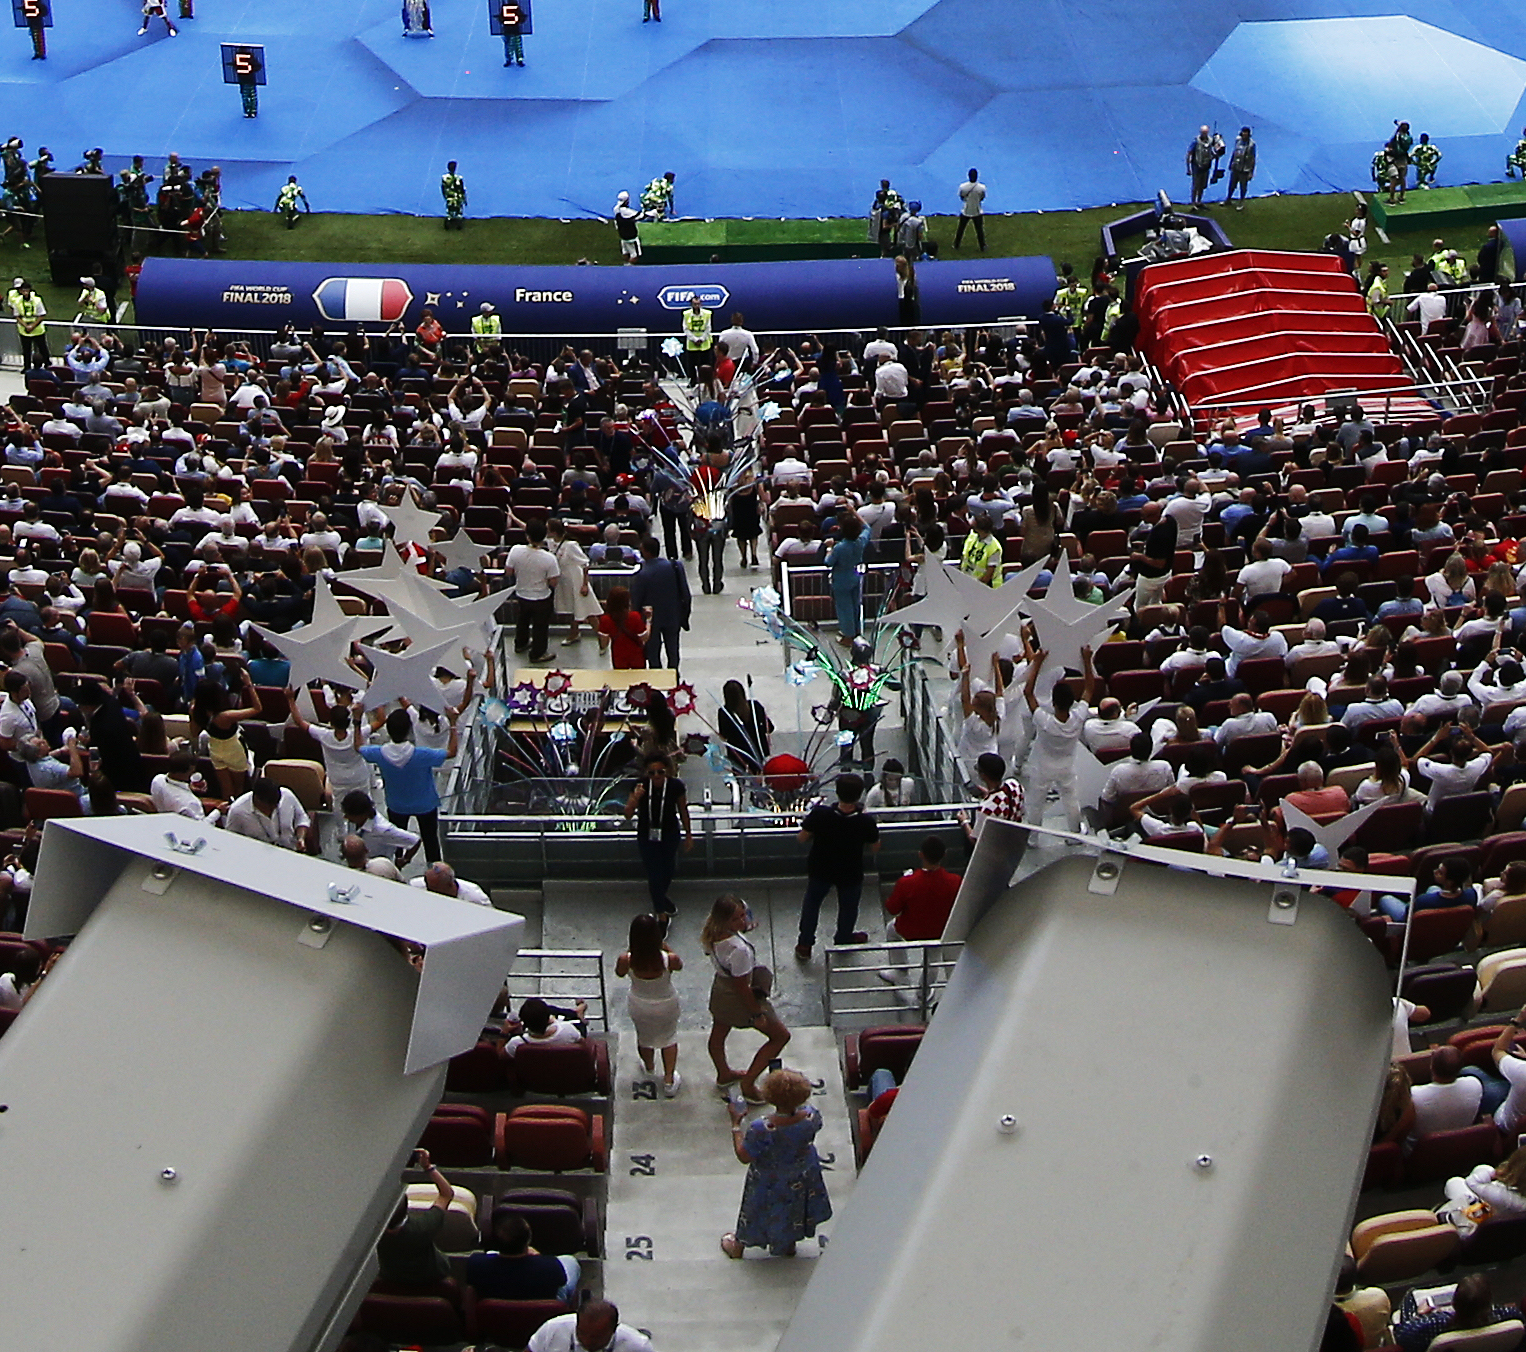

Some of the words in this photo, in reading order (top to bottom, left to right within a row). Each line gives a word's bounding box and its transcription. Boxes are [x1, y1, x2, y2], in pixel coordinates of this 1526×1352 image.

[503, 6, 518, 24] 5
[236, 54, 251, 73] 5
[514, 288, 573, 303] France
[667, 291, 720, 302] FIFAcom
[957, 283, 990, 293] FINAL
[990, 282, 1015, 292] 2018
[222, 291, 260, 303] FINAL
[261, 292, 292, 304] 2018
[633, 1081, 657, 1101] 23
[630, 1154, 655, 1177] 24
[626, 1235, 653, 1261] 25
